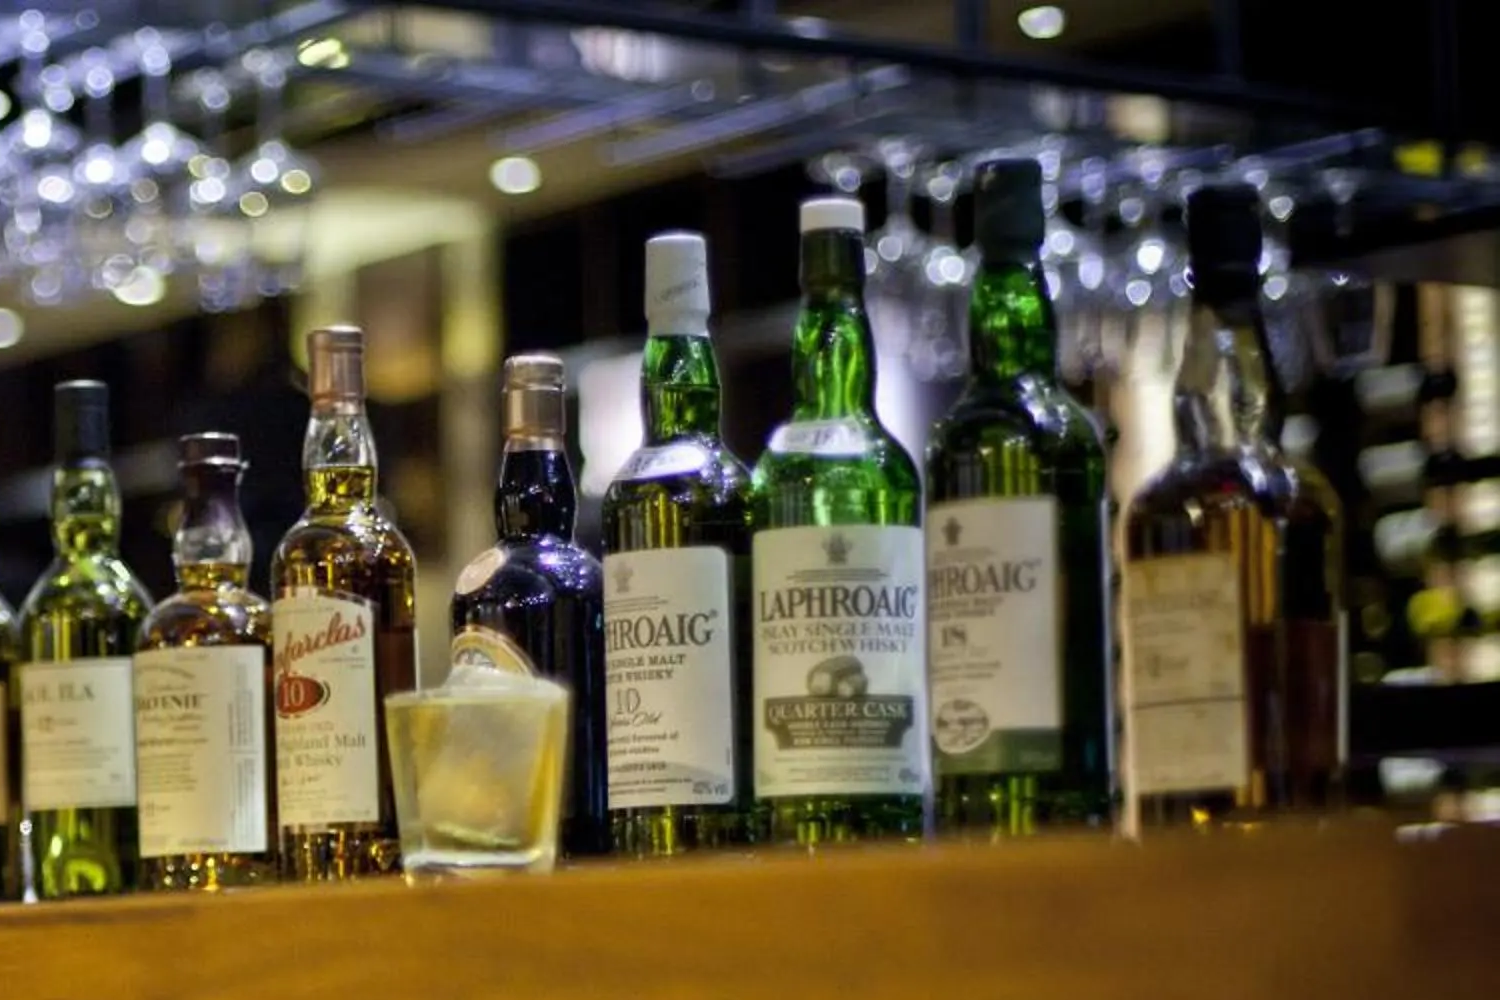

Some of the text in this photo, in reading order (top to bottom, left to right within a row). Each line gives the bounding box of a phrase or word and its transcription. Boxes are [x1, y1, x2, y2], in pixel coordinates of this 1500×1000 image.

[760, 584, 918, 622] LAPHROAIG
[805, 623, 869, 638] SINGLE
[283, 680, 305, 707] 10
[615, 686, 642, 715] 10
[769, 702, 908, 725] QUARTER CASK
